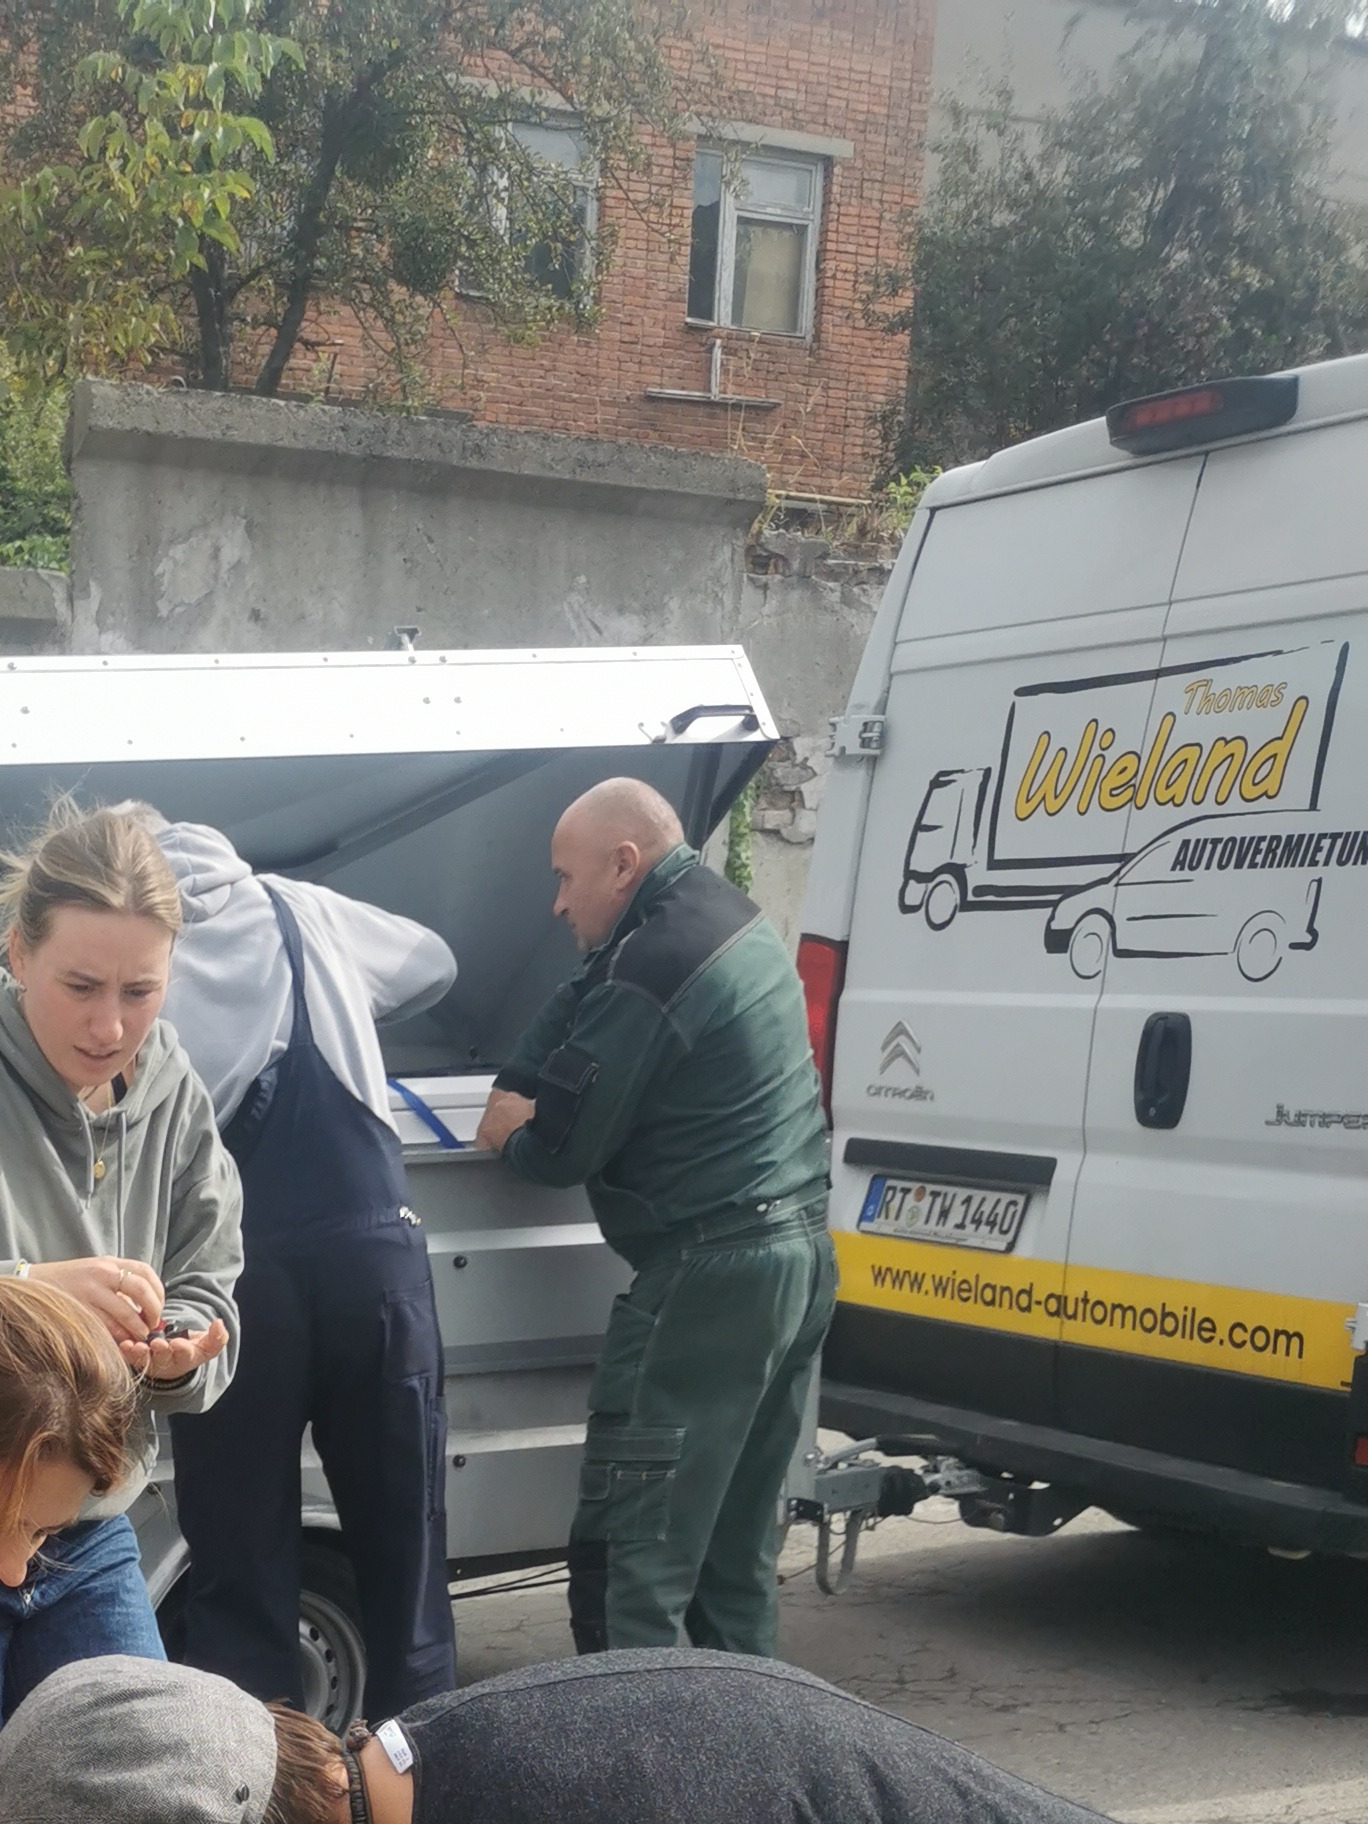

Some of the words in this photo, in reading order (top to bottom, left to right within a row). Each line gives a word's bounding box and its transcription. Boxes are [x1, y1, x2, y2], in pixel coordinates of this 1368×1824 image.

[1184, 678, 1288, 716] Thomas
[1015, 695, 1310, 822] Wieland
[876, 1185, 912, 1221] RT
[923, 1190, 958, 1228] TW
[953, 1194, 1019, 1236] 1440
[870, 1263, 1306, 1360] www.wieland-automobile.com
